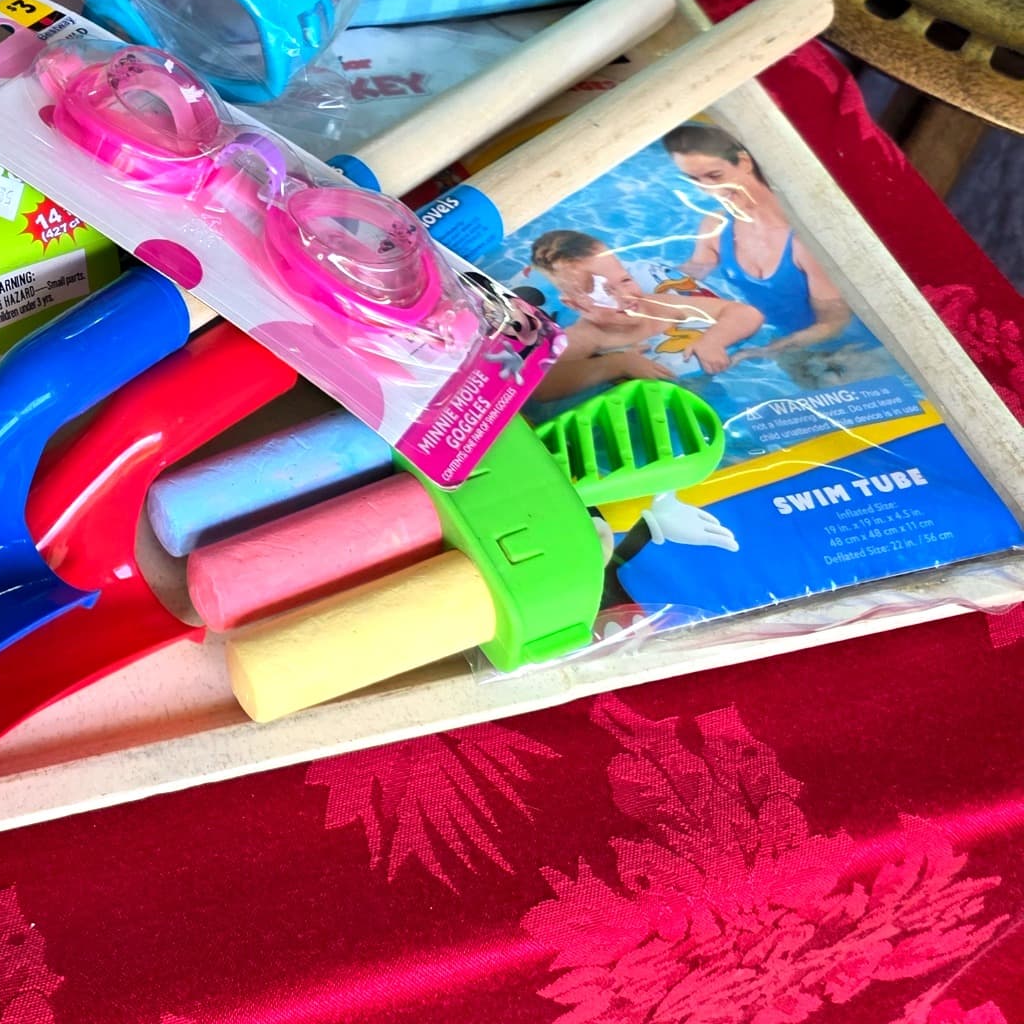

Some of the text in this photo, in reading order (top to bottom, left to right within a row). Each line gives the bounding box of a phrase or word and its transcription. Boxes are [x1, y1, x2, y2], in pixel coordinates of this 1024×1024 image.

[6, 0, 36, 14] $3
[35, 208, 62, 229] 14
[41, 223, 67, 242] (427
[20, 301, 36, 317] under
[36, 297, 43, 307] 3
[416, 369, 490, 456] MINNIE MOUSE
[768, 389, 860, 416] WARNING:
[446, 395, 491, 449] GOGGLES
[773, 468, 928, 515] SWIM TUBE
[836, 505, 875, 520] Inflated
[824, 525, 837, 535] 19
[860, 517, 872, 527] 19
[829, 536, 844, 547] 48
[823, 549, 866, 565] Deflated
[890, 540, 904, 551] 22
